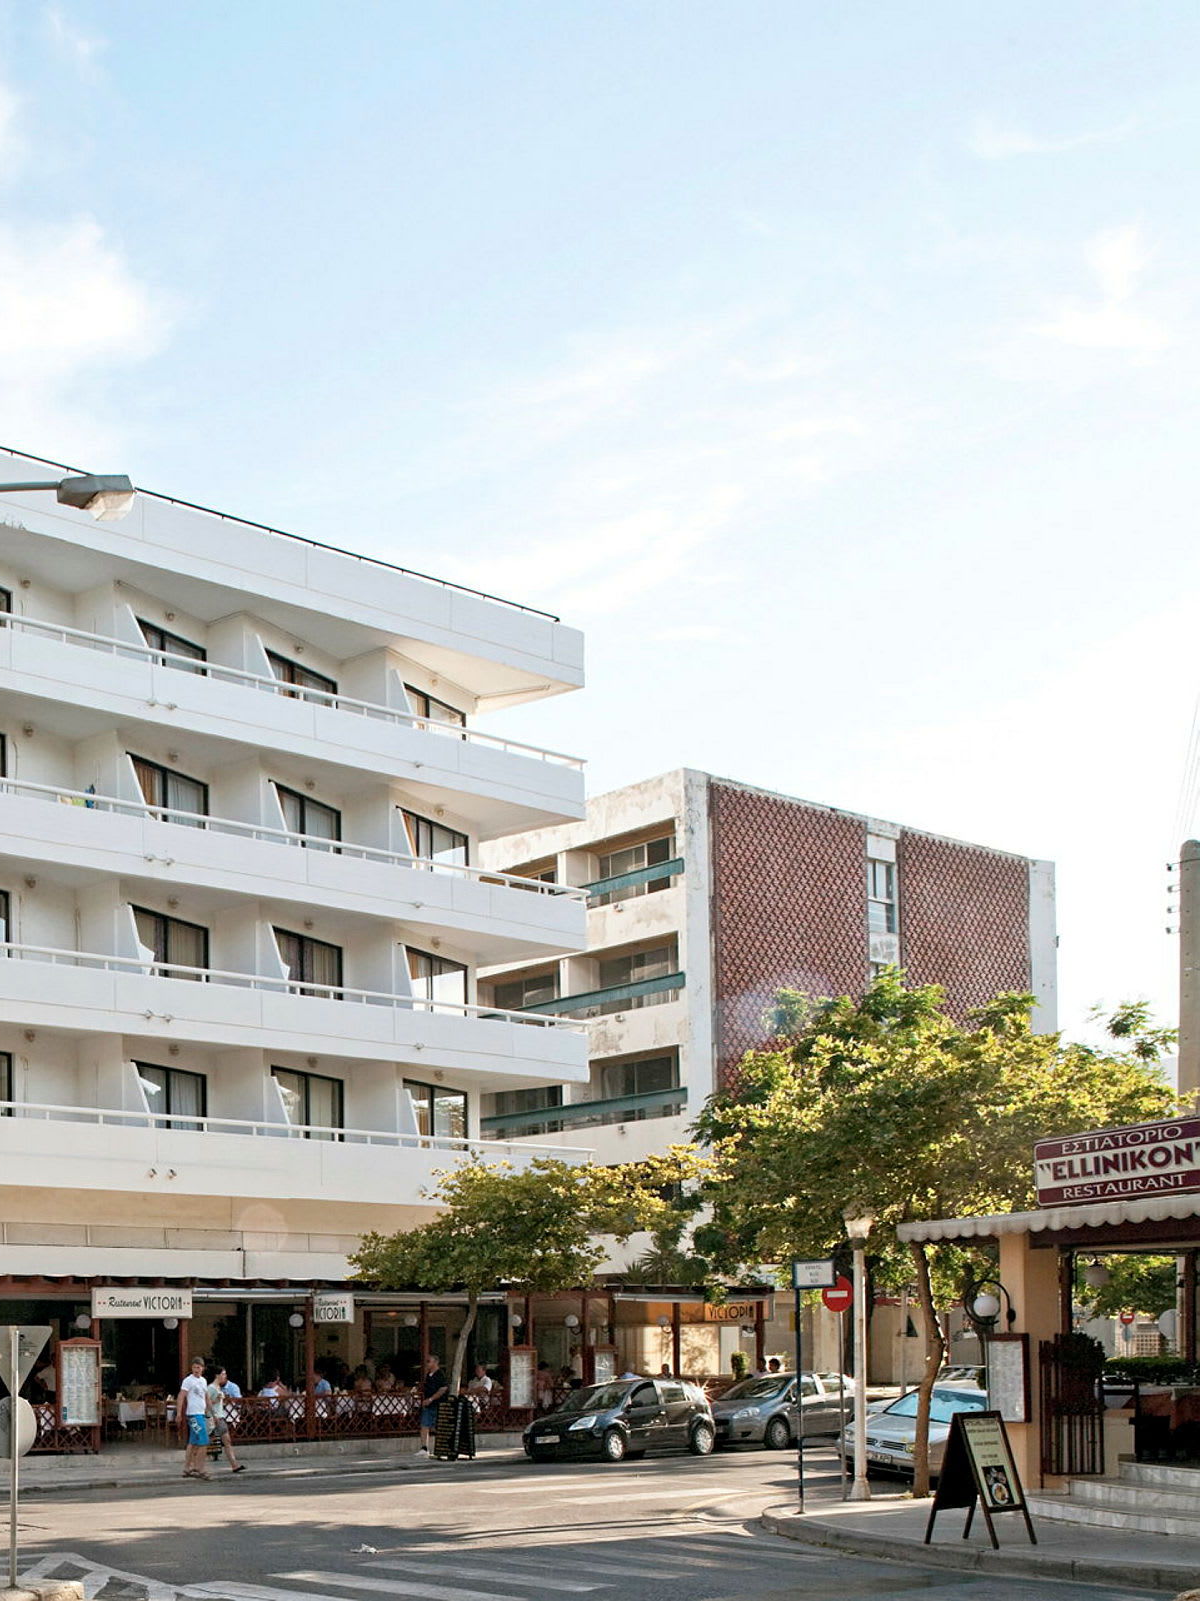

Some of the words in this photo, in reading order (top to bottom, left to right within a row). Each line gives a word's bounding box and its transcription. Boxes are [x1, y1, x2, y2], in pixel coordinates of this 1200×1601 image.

[1061, 1126, 1182, 1154] ΕΣΤΙΑΤΟΡΙΟ
[1063, 1173, 1186, 1198] RESTAURANT
[143, 1296, 182, 1310] VICTORIA
